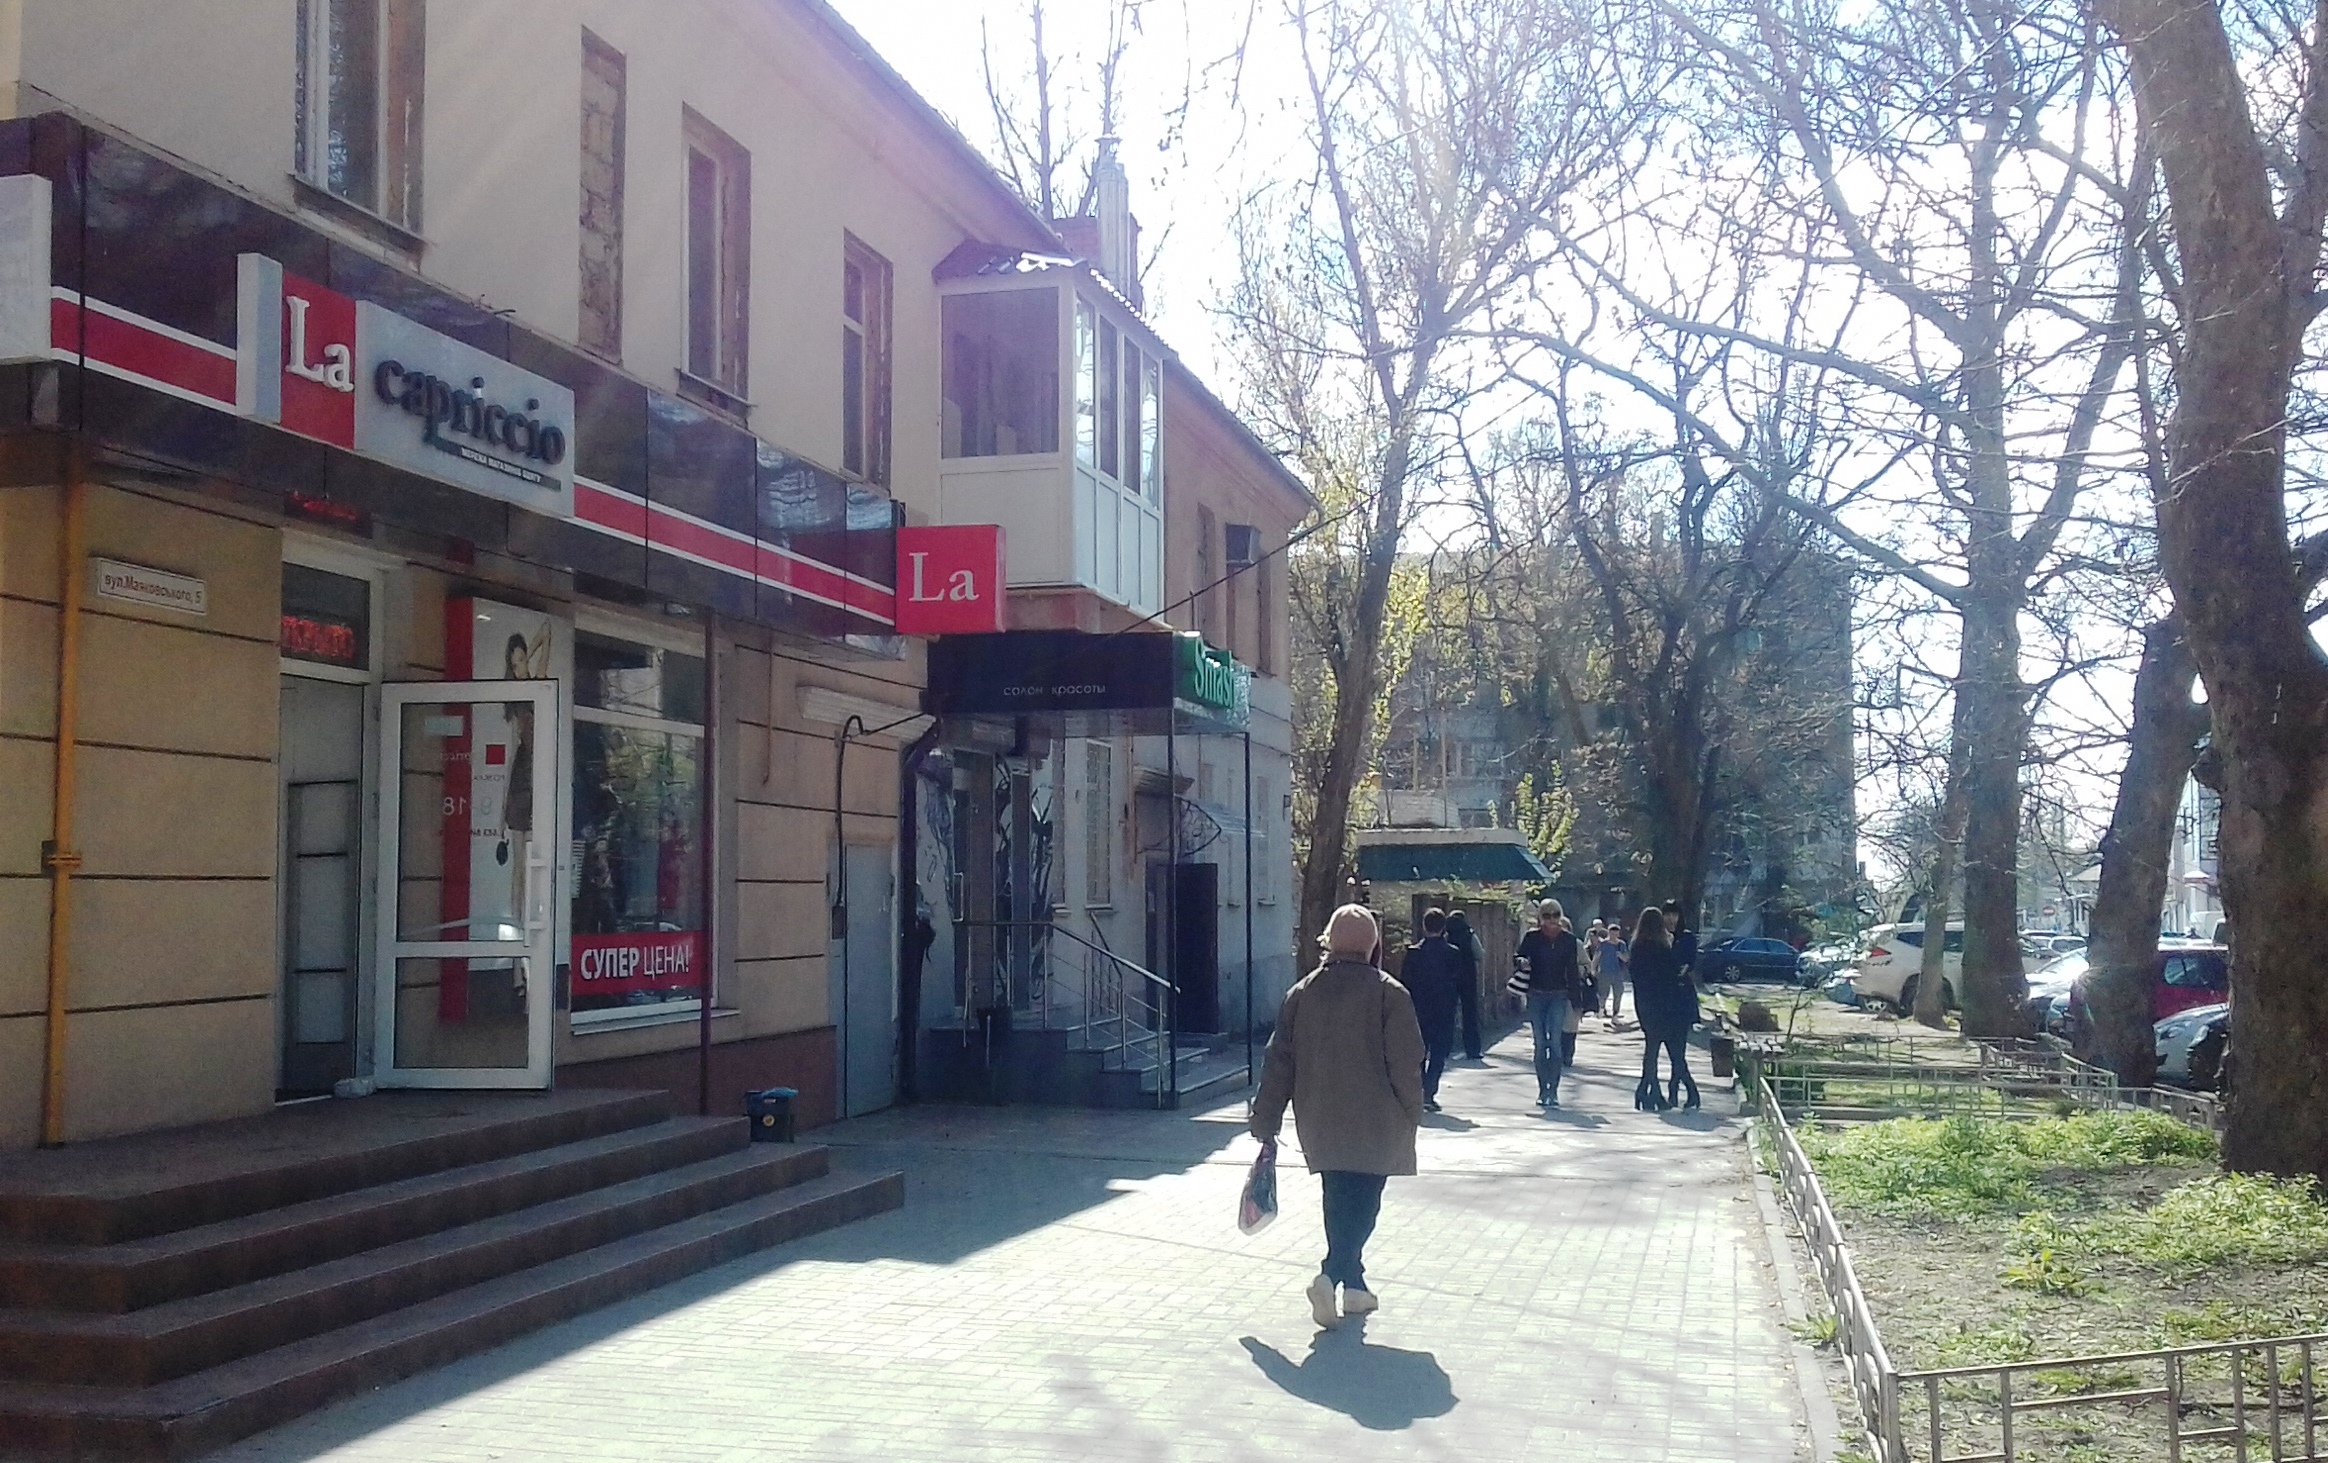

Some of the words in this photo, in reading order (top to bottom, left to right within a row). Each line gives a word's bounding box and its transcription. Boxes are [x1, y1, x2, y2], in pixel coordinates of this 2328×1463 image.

[285, 296, 354, 393] La
[909, 552, 979, 602] La
[195, 590, 202, 604] 5
[1051, 685, 1106, 697] красоты
[580, 947, 640, 980] СУПЕР
[643, 944, 689, 980] ЦЕНА!
